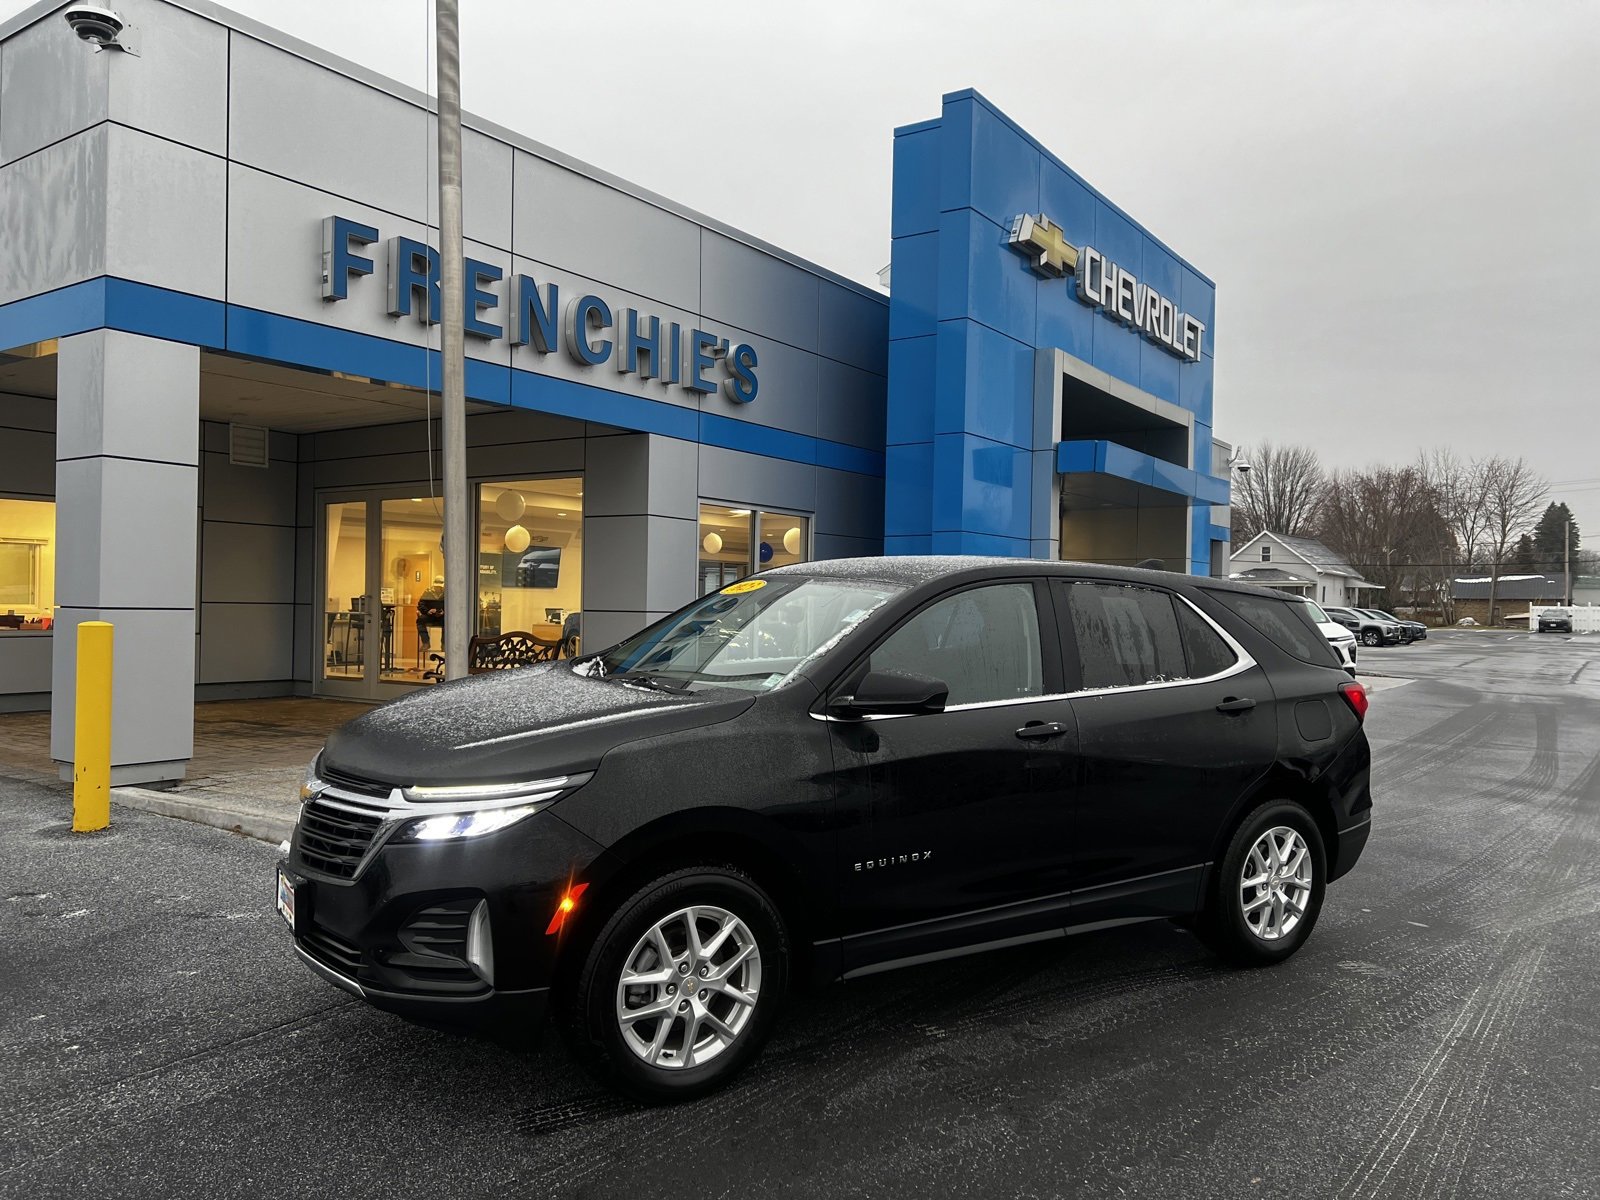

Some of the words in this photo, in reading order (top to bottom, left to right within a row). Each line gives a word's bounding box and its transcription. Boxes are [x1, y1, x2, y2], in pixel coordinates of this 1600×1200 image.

[324, 215, 759, 404] FRENCHIE'S
[1081, 244, 1206, 363] CHEVROLET
[854, 850, 932, 872] EQUINOX
